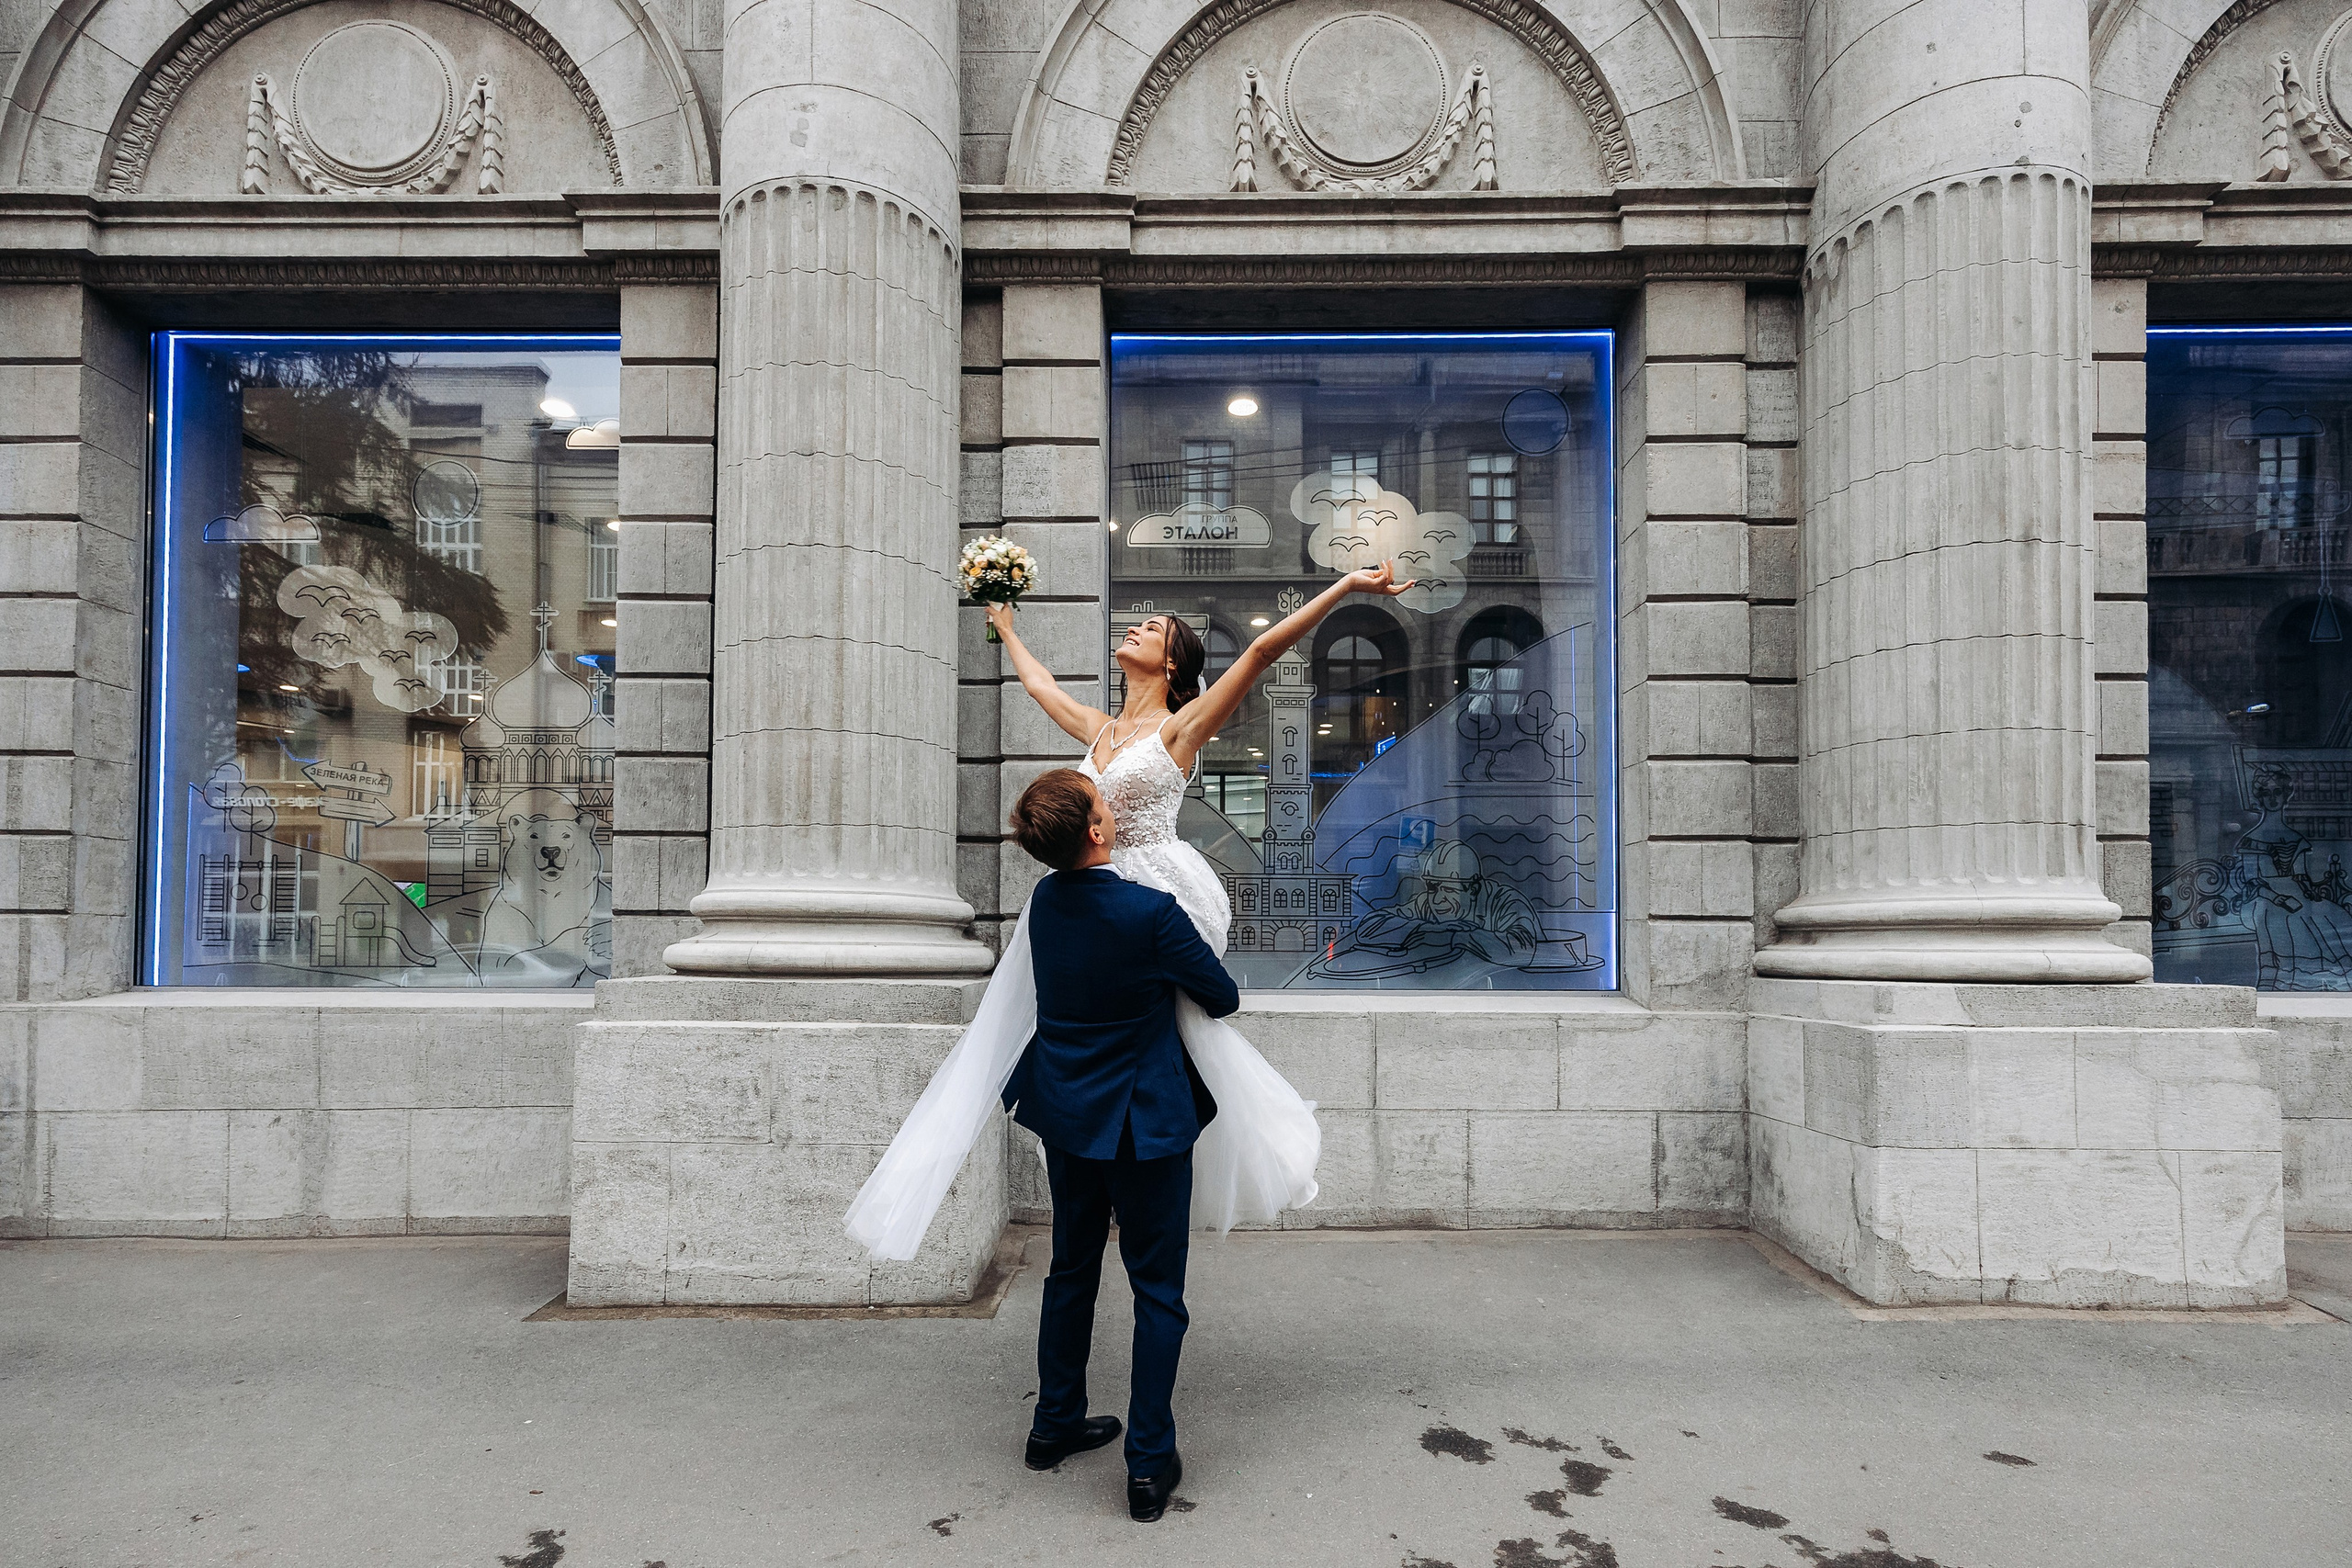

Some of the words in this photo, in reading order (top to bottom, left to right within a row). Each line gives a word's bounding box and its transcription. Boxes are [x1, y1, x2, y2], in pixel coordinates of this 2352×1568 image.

[1202, 514, 1238, 524] ГРУППА
[1163, 526, 1238, 540] ЭТАЛОН
[310, 768, 356, 783] ЗЕЛЕНАЯ
[358, 775, 384, 787] РЕКА
